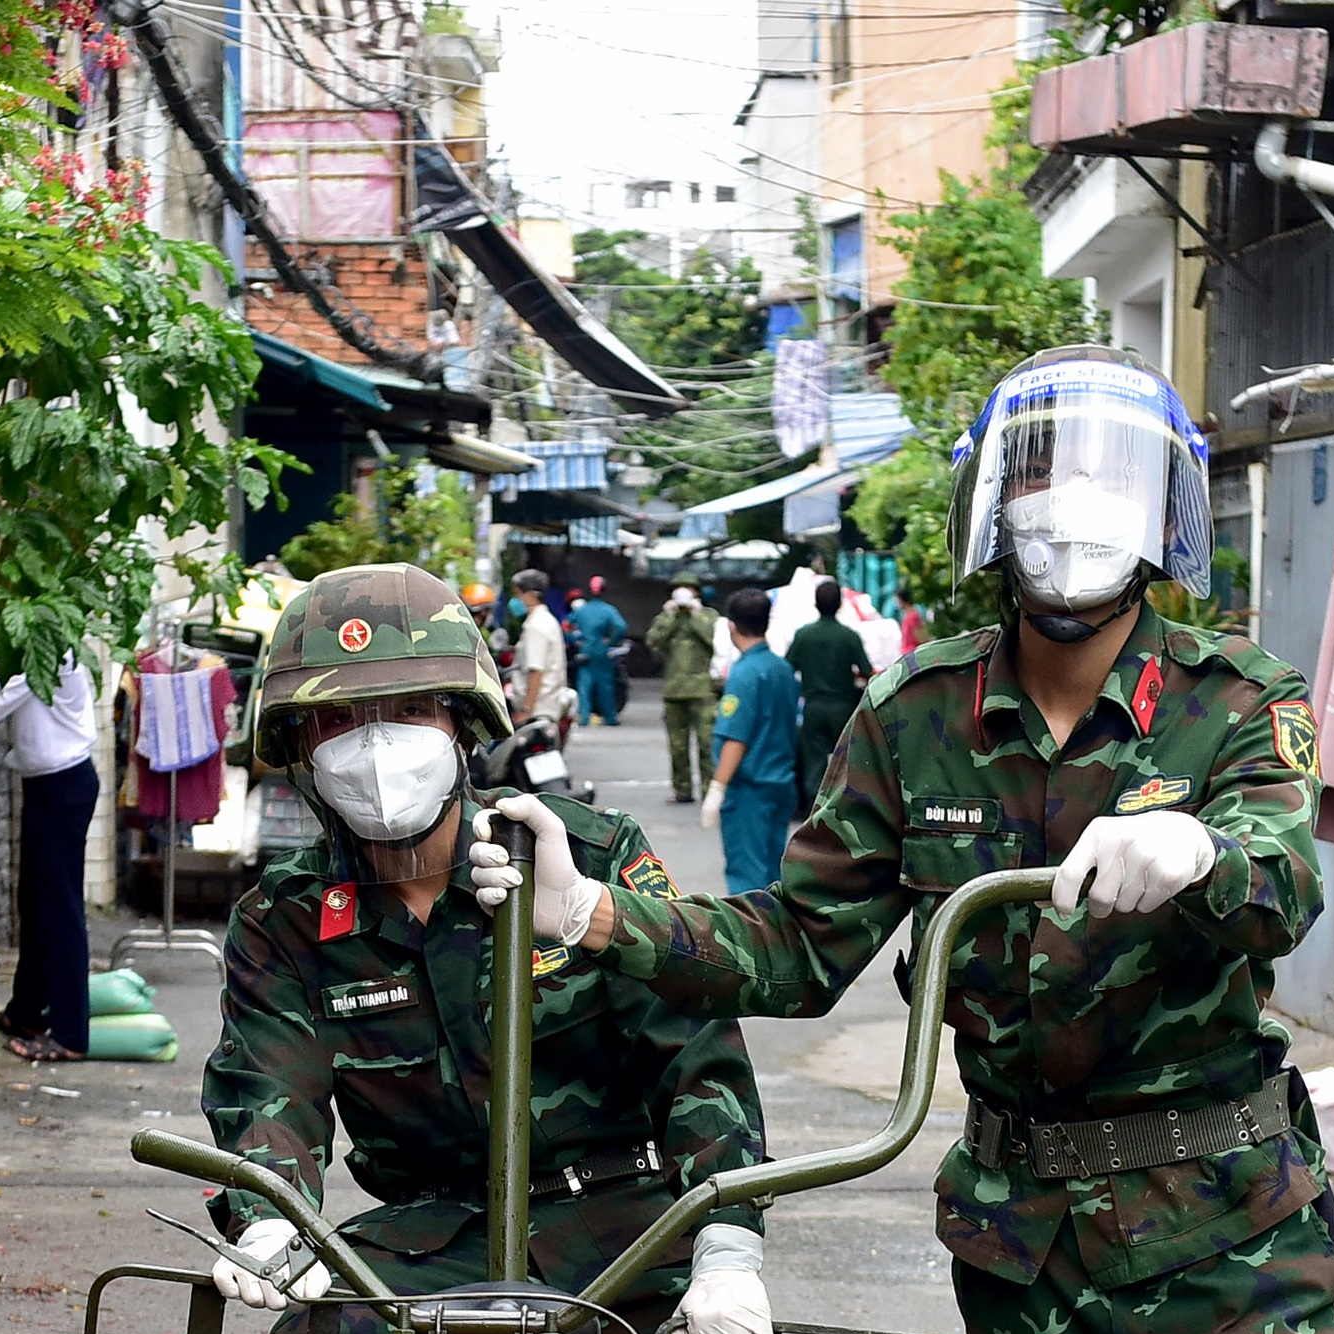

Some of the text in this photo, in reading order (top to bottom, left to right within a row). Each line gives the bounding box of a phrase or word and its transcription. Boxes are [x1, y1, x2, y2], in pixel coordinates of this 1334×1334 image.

[1019, 370, 1066, 388] Face
[925, 805, 945, 821] BÙI
[357, 991, 389, 1008] THANH
